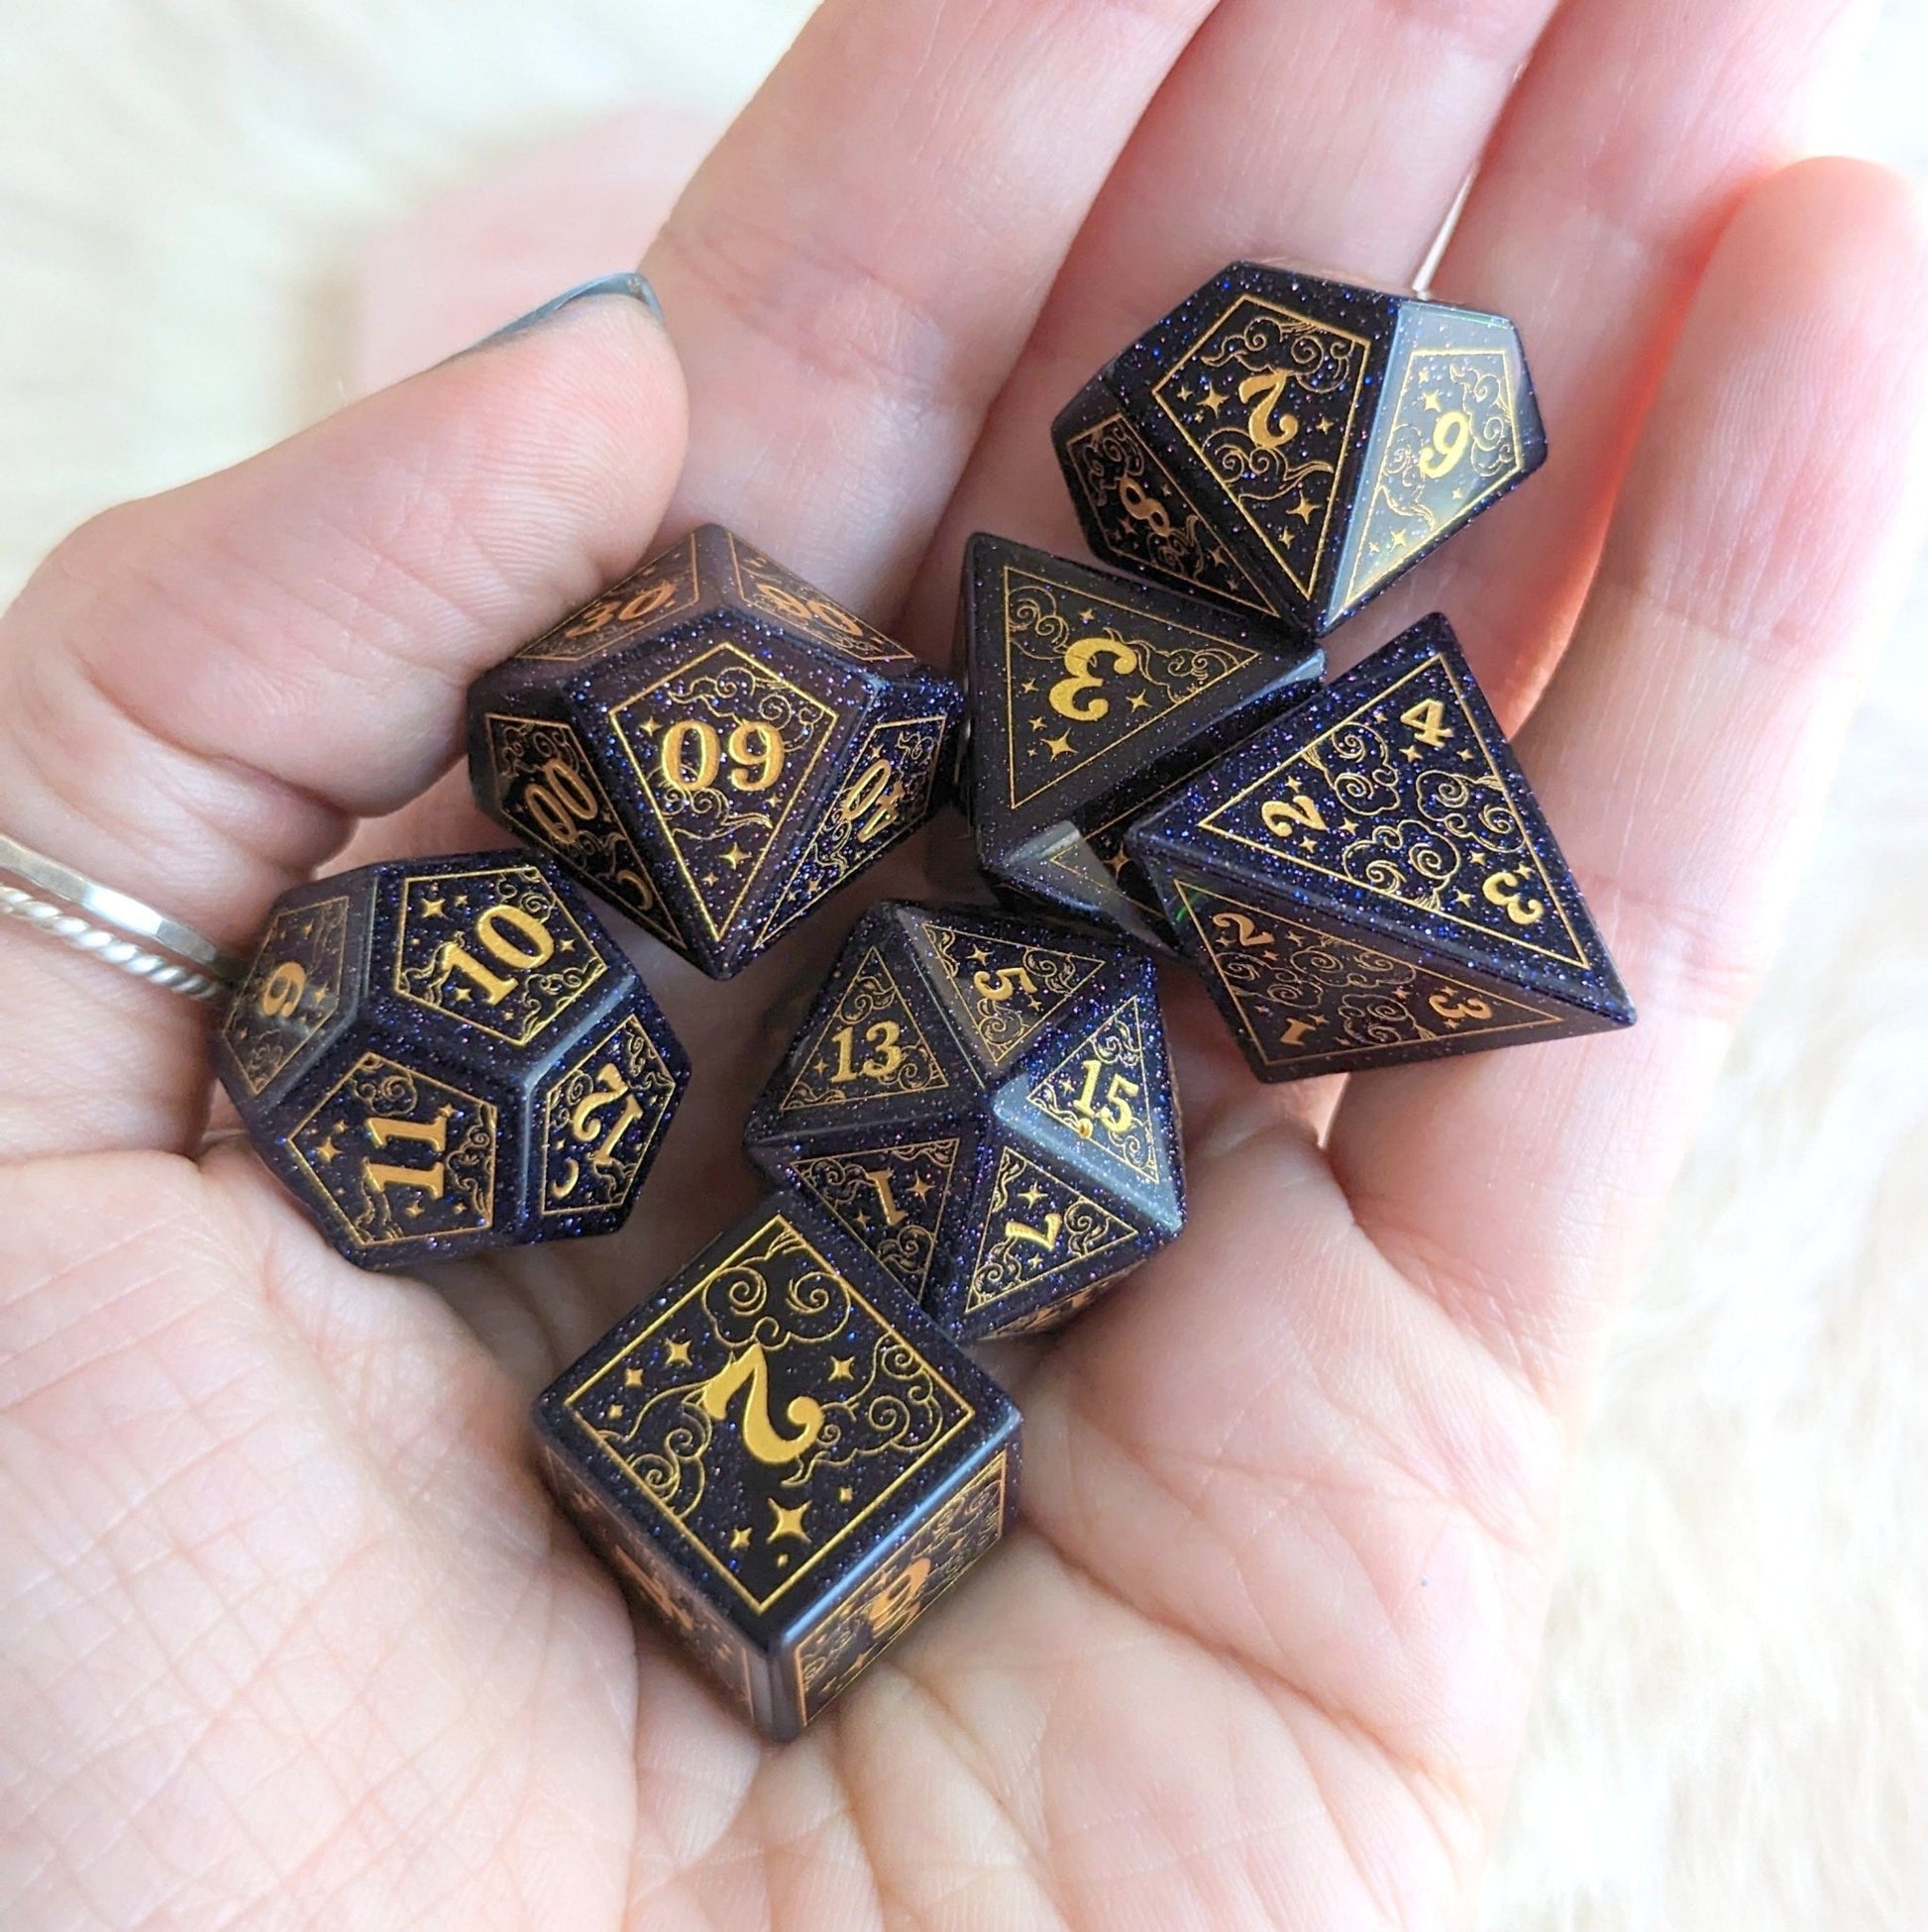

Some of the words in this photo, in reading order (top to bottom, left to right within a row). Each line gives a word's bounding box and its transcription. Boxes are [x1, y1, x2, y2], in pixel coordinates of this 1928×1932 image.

[1238, 369, 1299, 448] 2
[1120, 477, 1170, 536] 8
[565, 582, 677, 639] 30
[1048, 637, 1137, 721] 3
[1400, 698, 1454, 748] 4
[524, 759, 598, 844] 00
[1261, 796, 1328, 838] 2
[1482, 872, 1545, 924] 3
[443, 904, 556, 1006] 10
[1213, 912, 1275, 948] 2
[973, 966, 1038, 1002] 5
[1427, 993, 1493, 1020] 3
[829, 1020, 904, 1083] 13
[1278, 1020, 1318, 1047] 1
[572, 1062, 644, 1165] 12
[1071, 1059, 1139, 1133] 15
[363, 1116, 449, 1200] 11
[699, 1343, 825, 1464] 2
